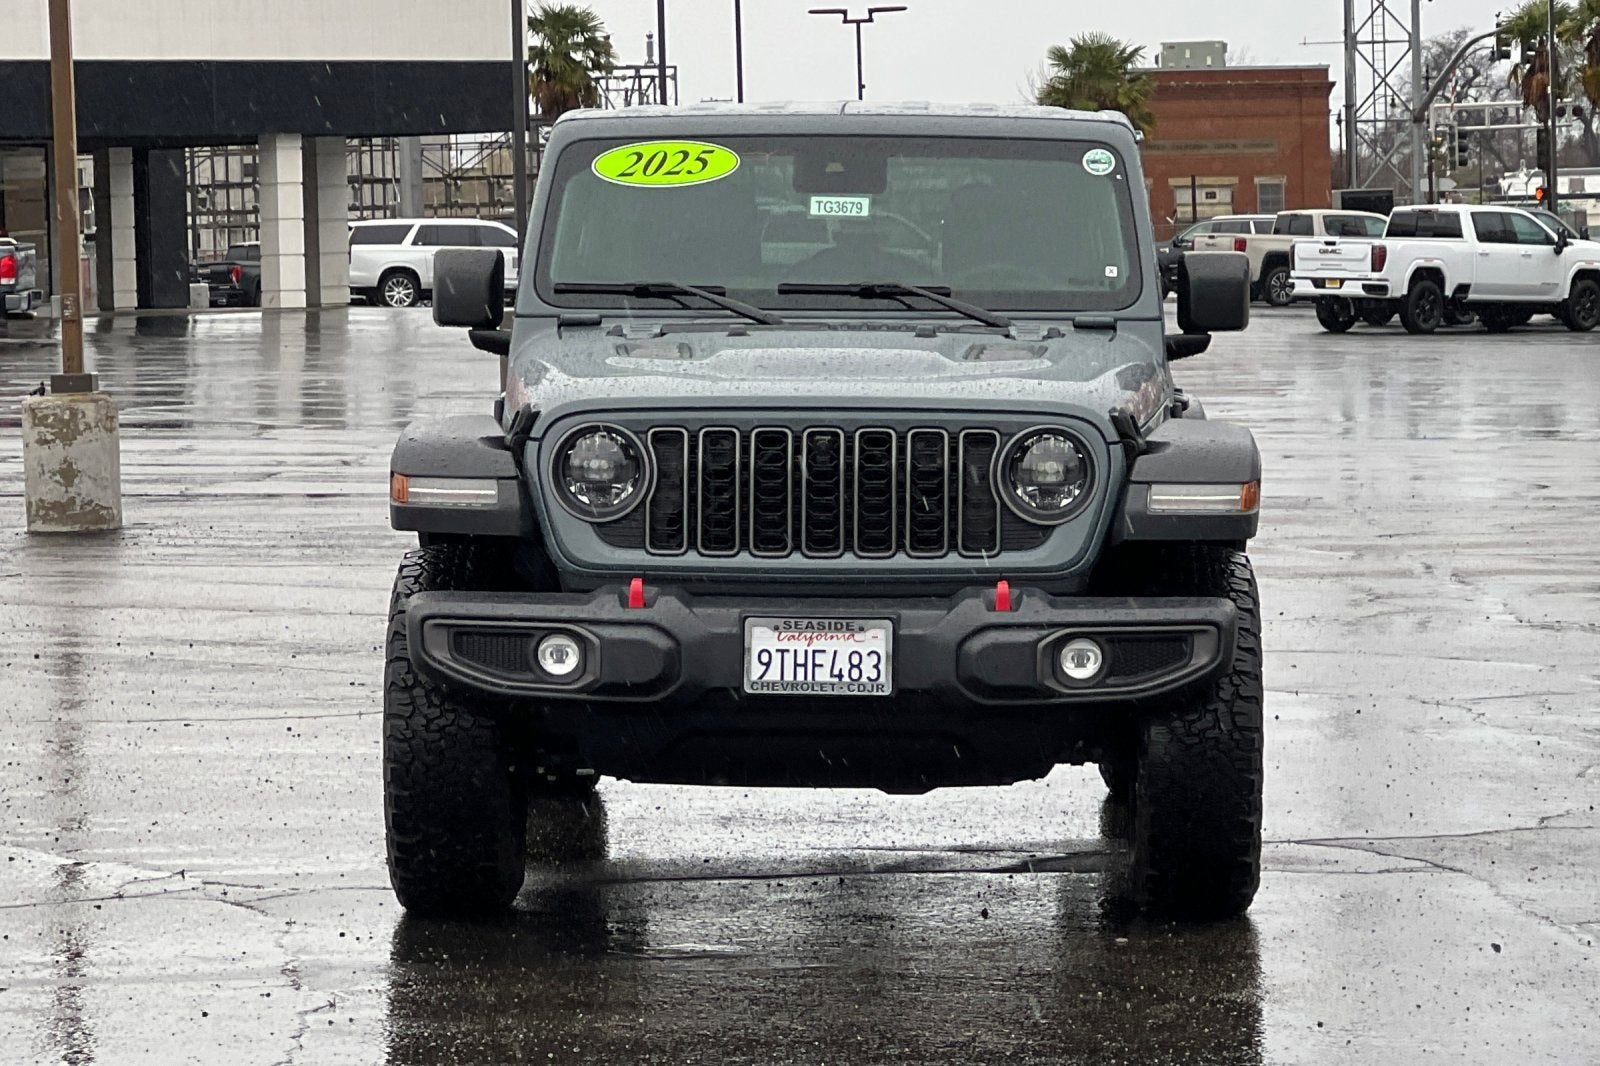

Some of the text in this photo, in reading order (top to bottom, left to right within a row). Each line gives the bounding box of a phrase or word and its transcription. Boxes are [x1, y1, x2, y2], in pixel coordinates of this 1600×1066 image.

[616, 150, 716, 177] 2025
[815, 200, 863, 214] TG3679
[783, 620, 855, 631] SEASIDE
[776, 631, 865, 647] California
[757, 649, 882, 682] 9THF483
[750, 682, 885, 693] CHEVROLET CDJR
